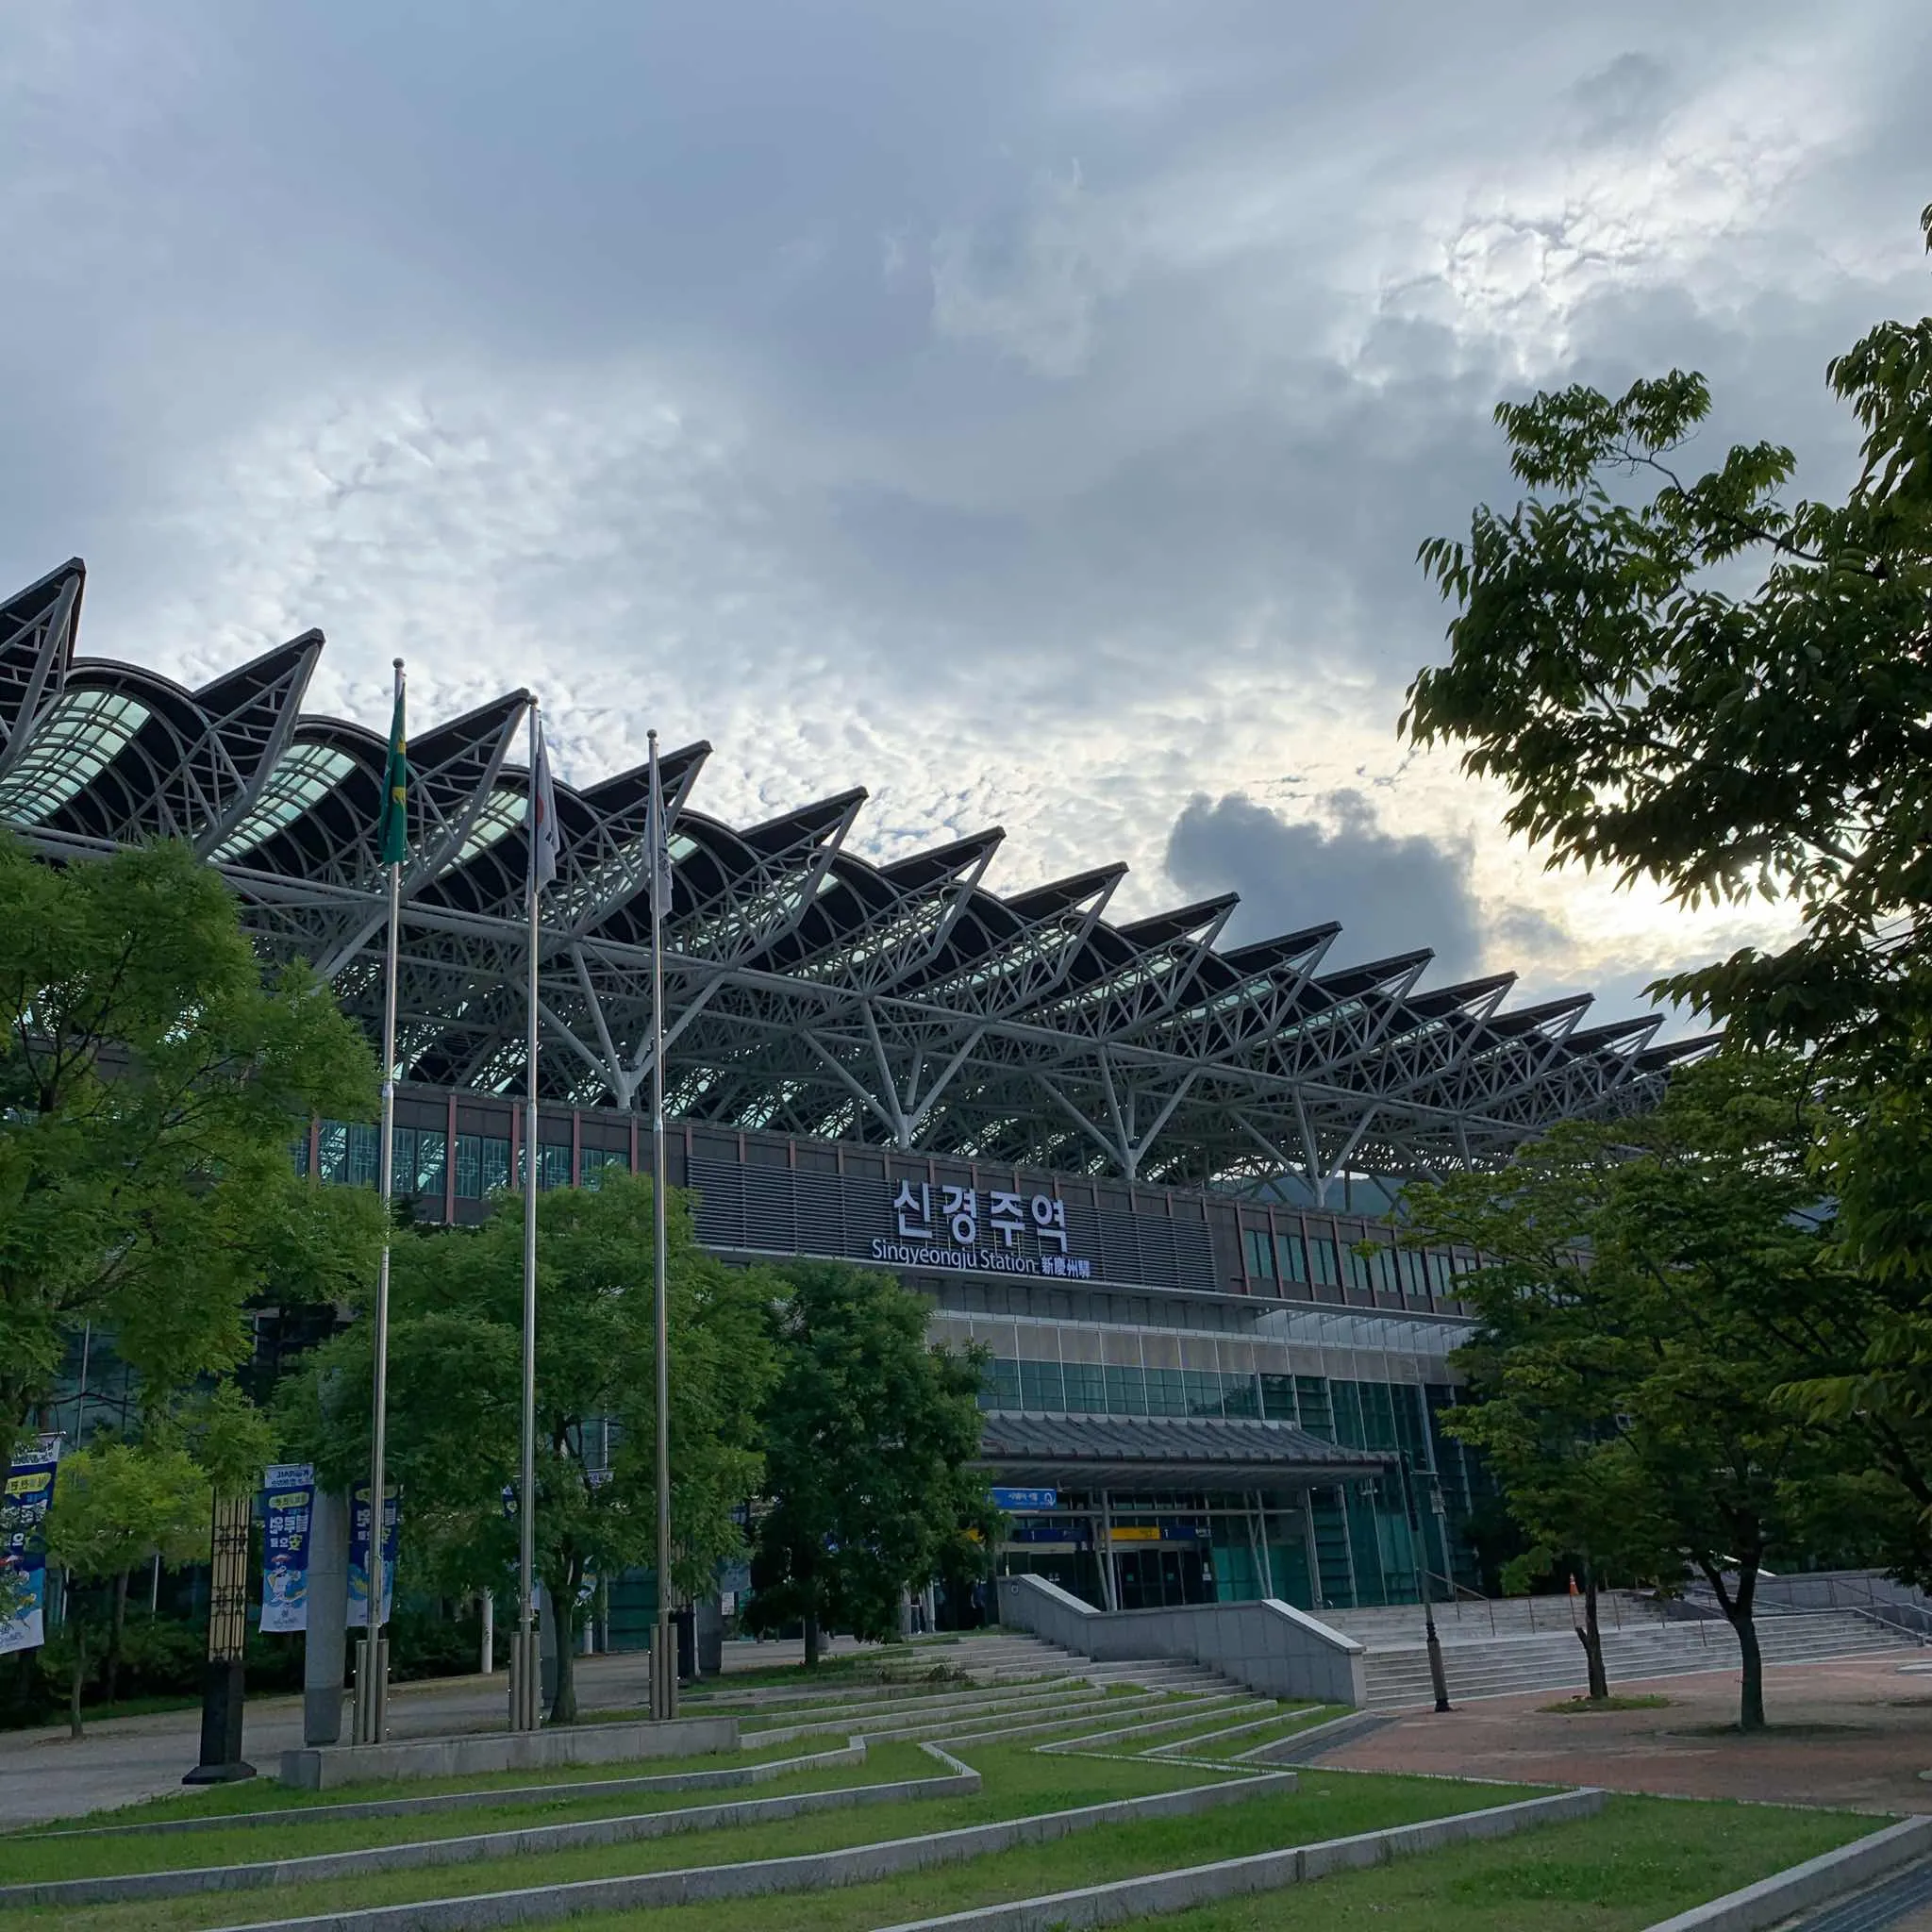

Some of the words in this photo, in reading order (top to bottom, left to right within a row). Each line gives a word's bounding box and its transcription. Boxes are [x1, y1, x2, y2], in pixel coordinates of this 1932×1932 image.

[893, 1179, 1068, 1254] 신경주역
[872, 1238, 977, 1271] Singyeongju
[980, 1249, 1036, 1274] Station
